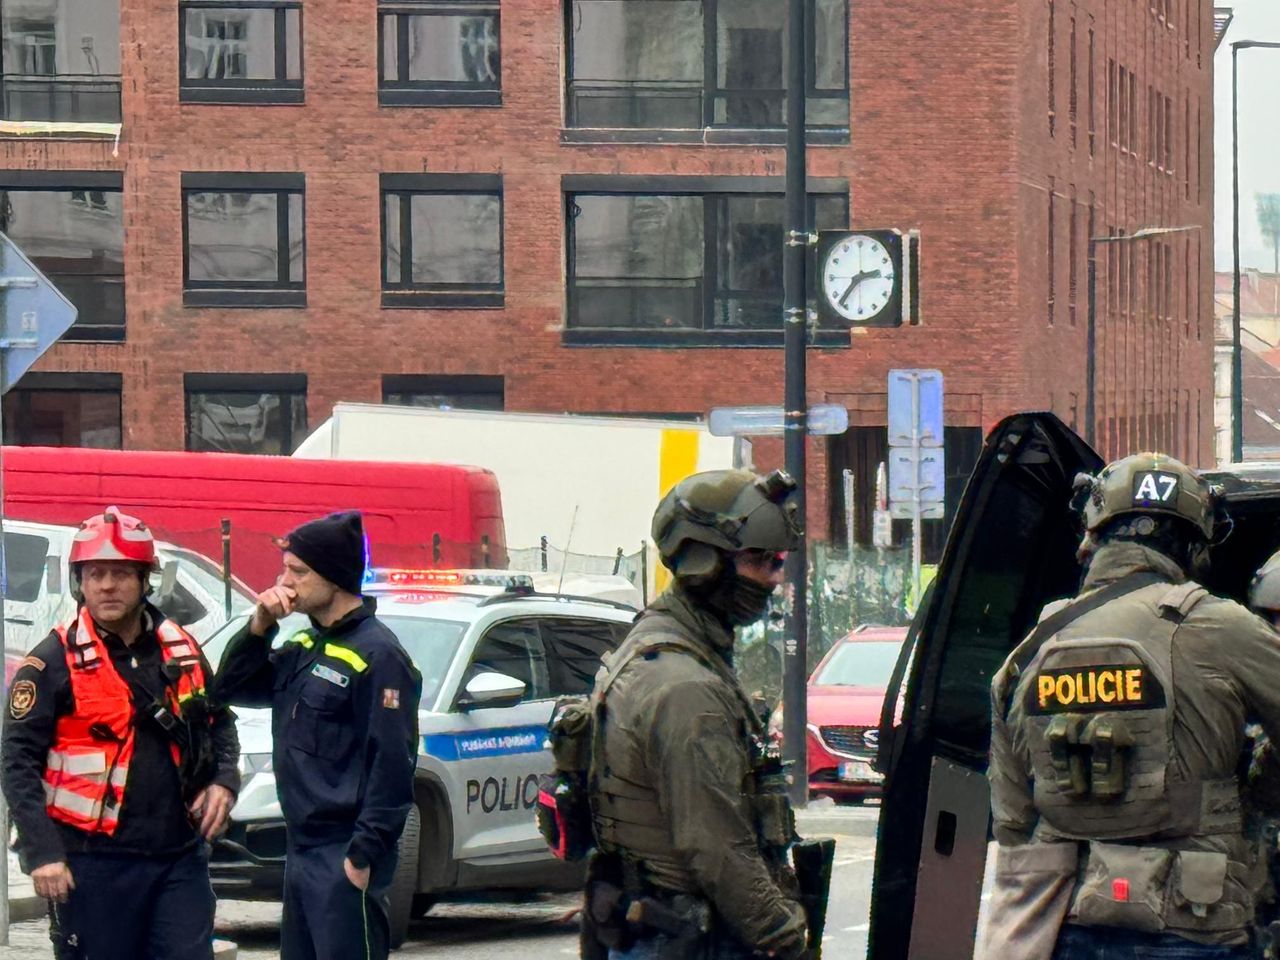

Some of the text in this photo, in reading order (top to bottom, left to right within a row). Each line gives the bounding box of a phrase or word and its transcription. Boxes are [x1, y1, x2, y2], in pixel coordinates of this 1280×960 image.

[1135, 473, 1177, 501] A7
[1038, 669, 1142, 708] POLICIE
[466, 773, 540, 815] POLIC
